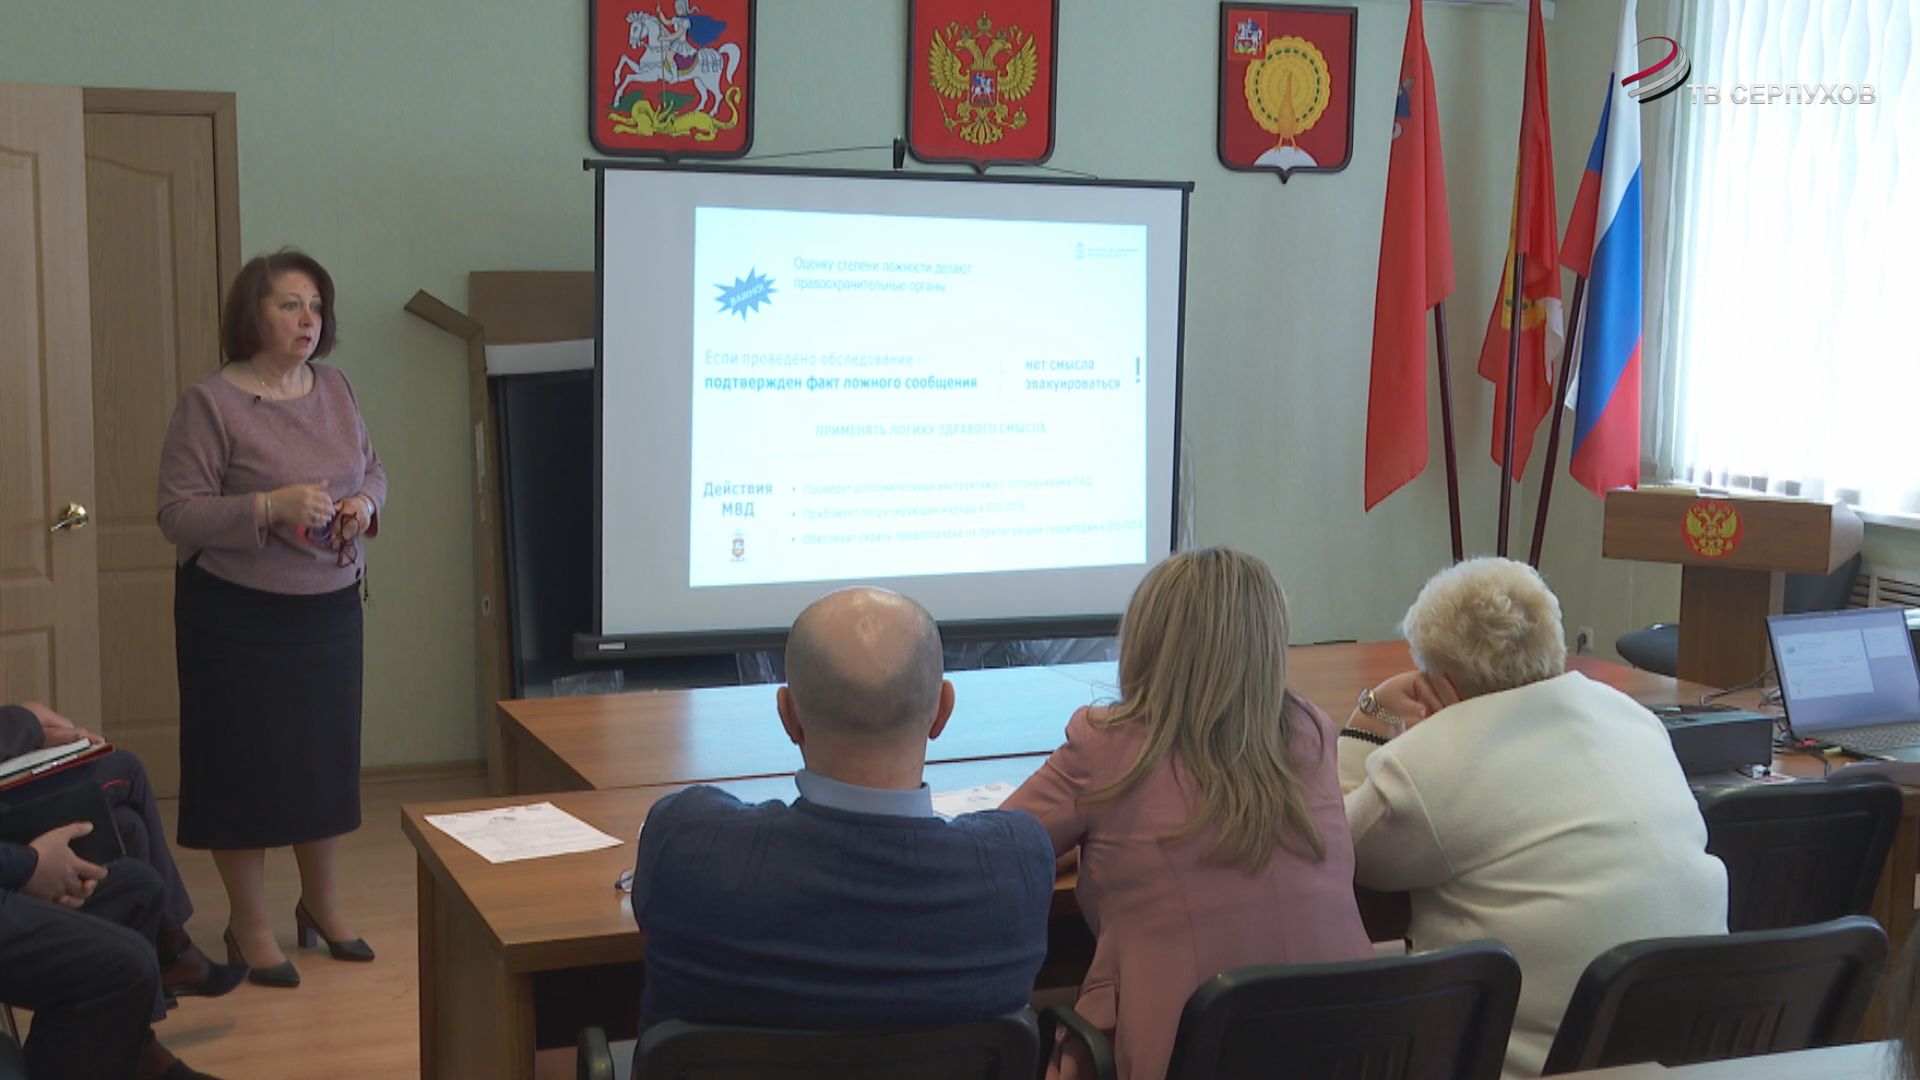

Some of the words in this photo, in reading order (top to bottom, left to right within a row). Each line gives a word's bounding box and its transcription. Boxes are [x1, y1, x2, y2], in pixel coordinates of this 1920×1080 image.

[794, 256, 833, 272] Оценку
[836, 260, 879, 272] степени
[882, 261, 932, 274] ложности
[935, 263, 972, 276] делают
[794, 278, 907, 293] правоохранительные
[909, 281, 945, 294] органы
[704, 349, 738, 365] Если
[743, 353, 817, 368] проведено
[820, 352, 913, 367] обследование
[1025, 359, 1046, 370] нет
[1050, 359, 1095, 371] смысла
[704, 376, 803, 391] подтвержден
[806, 375, 839, 391] факт
[842, 376, 902, 390] ложного
[904, 374, 978, 390] сообщения
[1024, 378, 1121, 393] эвакуироваться
[816, 424, 887, 437] ПРИМЕНЯТЬ
[890, 424, 934, 436] ЛОГИКУ
[938, 423, 997, 436] ЗДРАВОГО
[999, 423, 1047, 434] СМЫСЛА
[703, 479, 773, 498] Действия
[721, 501, 755, 518] МВД
